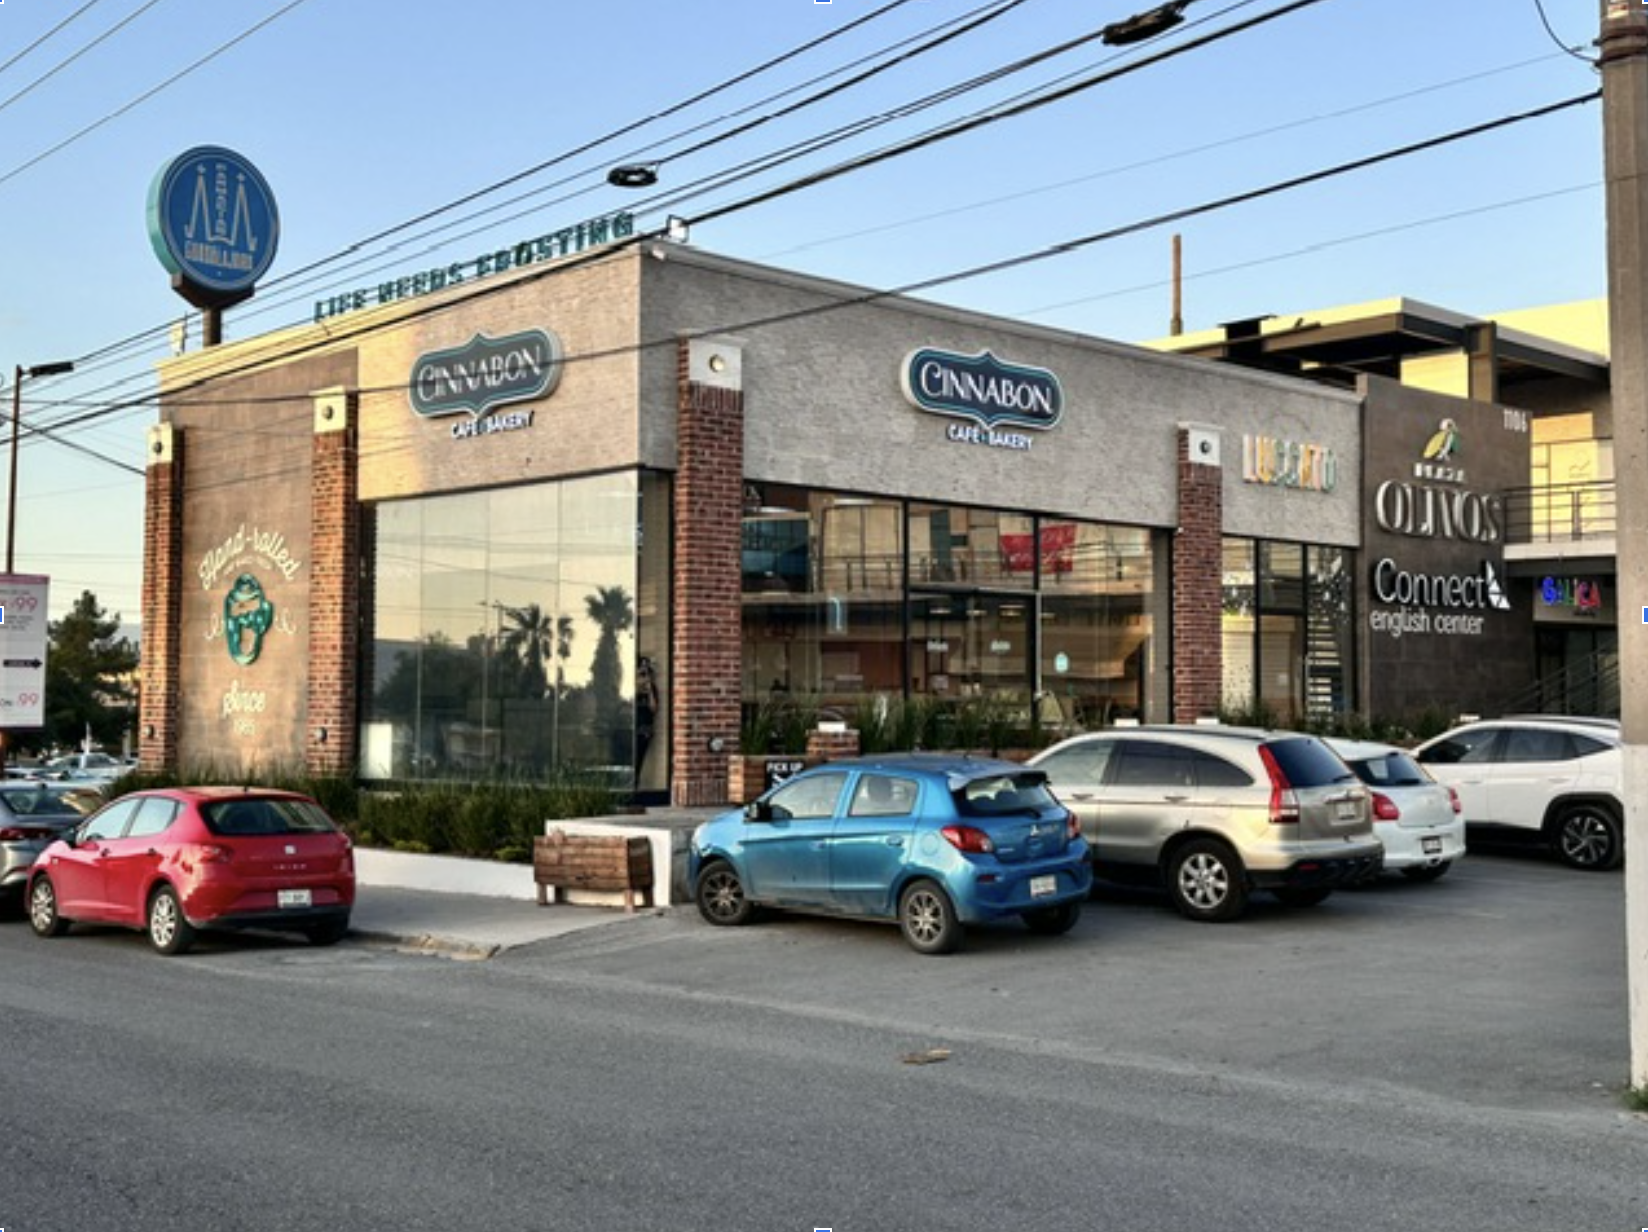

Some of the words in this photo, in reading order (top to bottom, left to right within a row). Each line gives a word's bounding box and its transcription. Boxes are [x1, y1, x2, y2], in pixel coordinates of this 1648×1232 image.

[417, 345, 541, 401] CINNABON
[920, 361, 1053, 414] CINNABON
[487, 411, 534, 433] BAKERY
[988, 430, 1033, 451] BAKERY
[1376, 480, 1500, 541] OLIVOS
[1374, 558, 1486, 608] Connect
[1369, 605, 1430, 638] english
[1434, 614, 1484, 635] center
[766, 761, 788, 773] PICK
